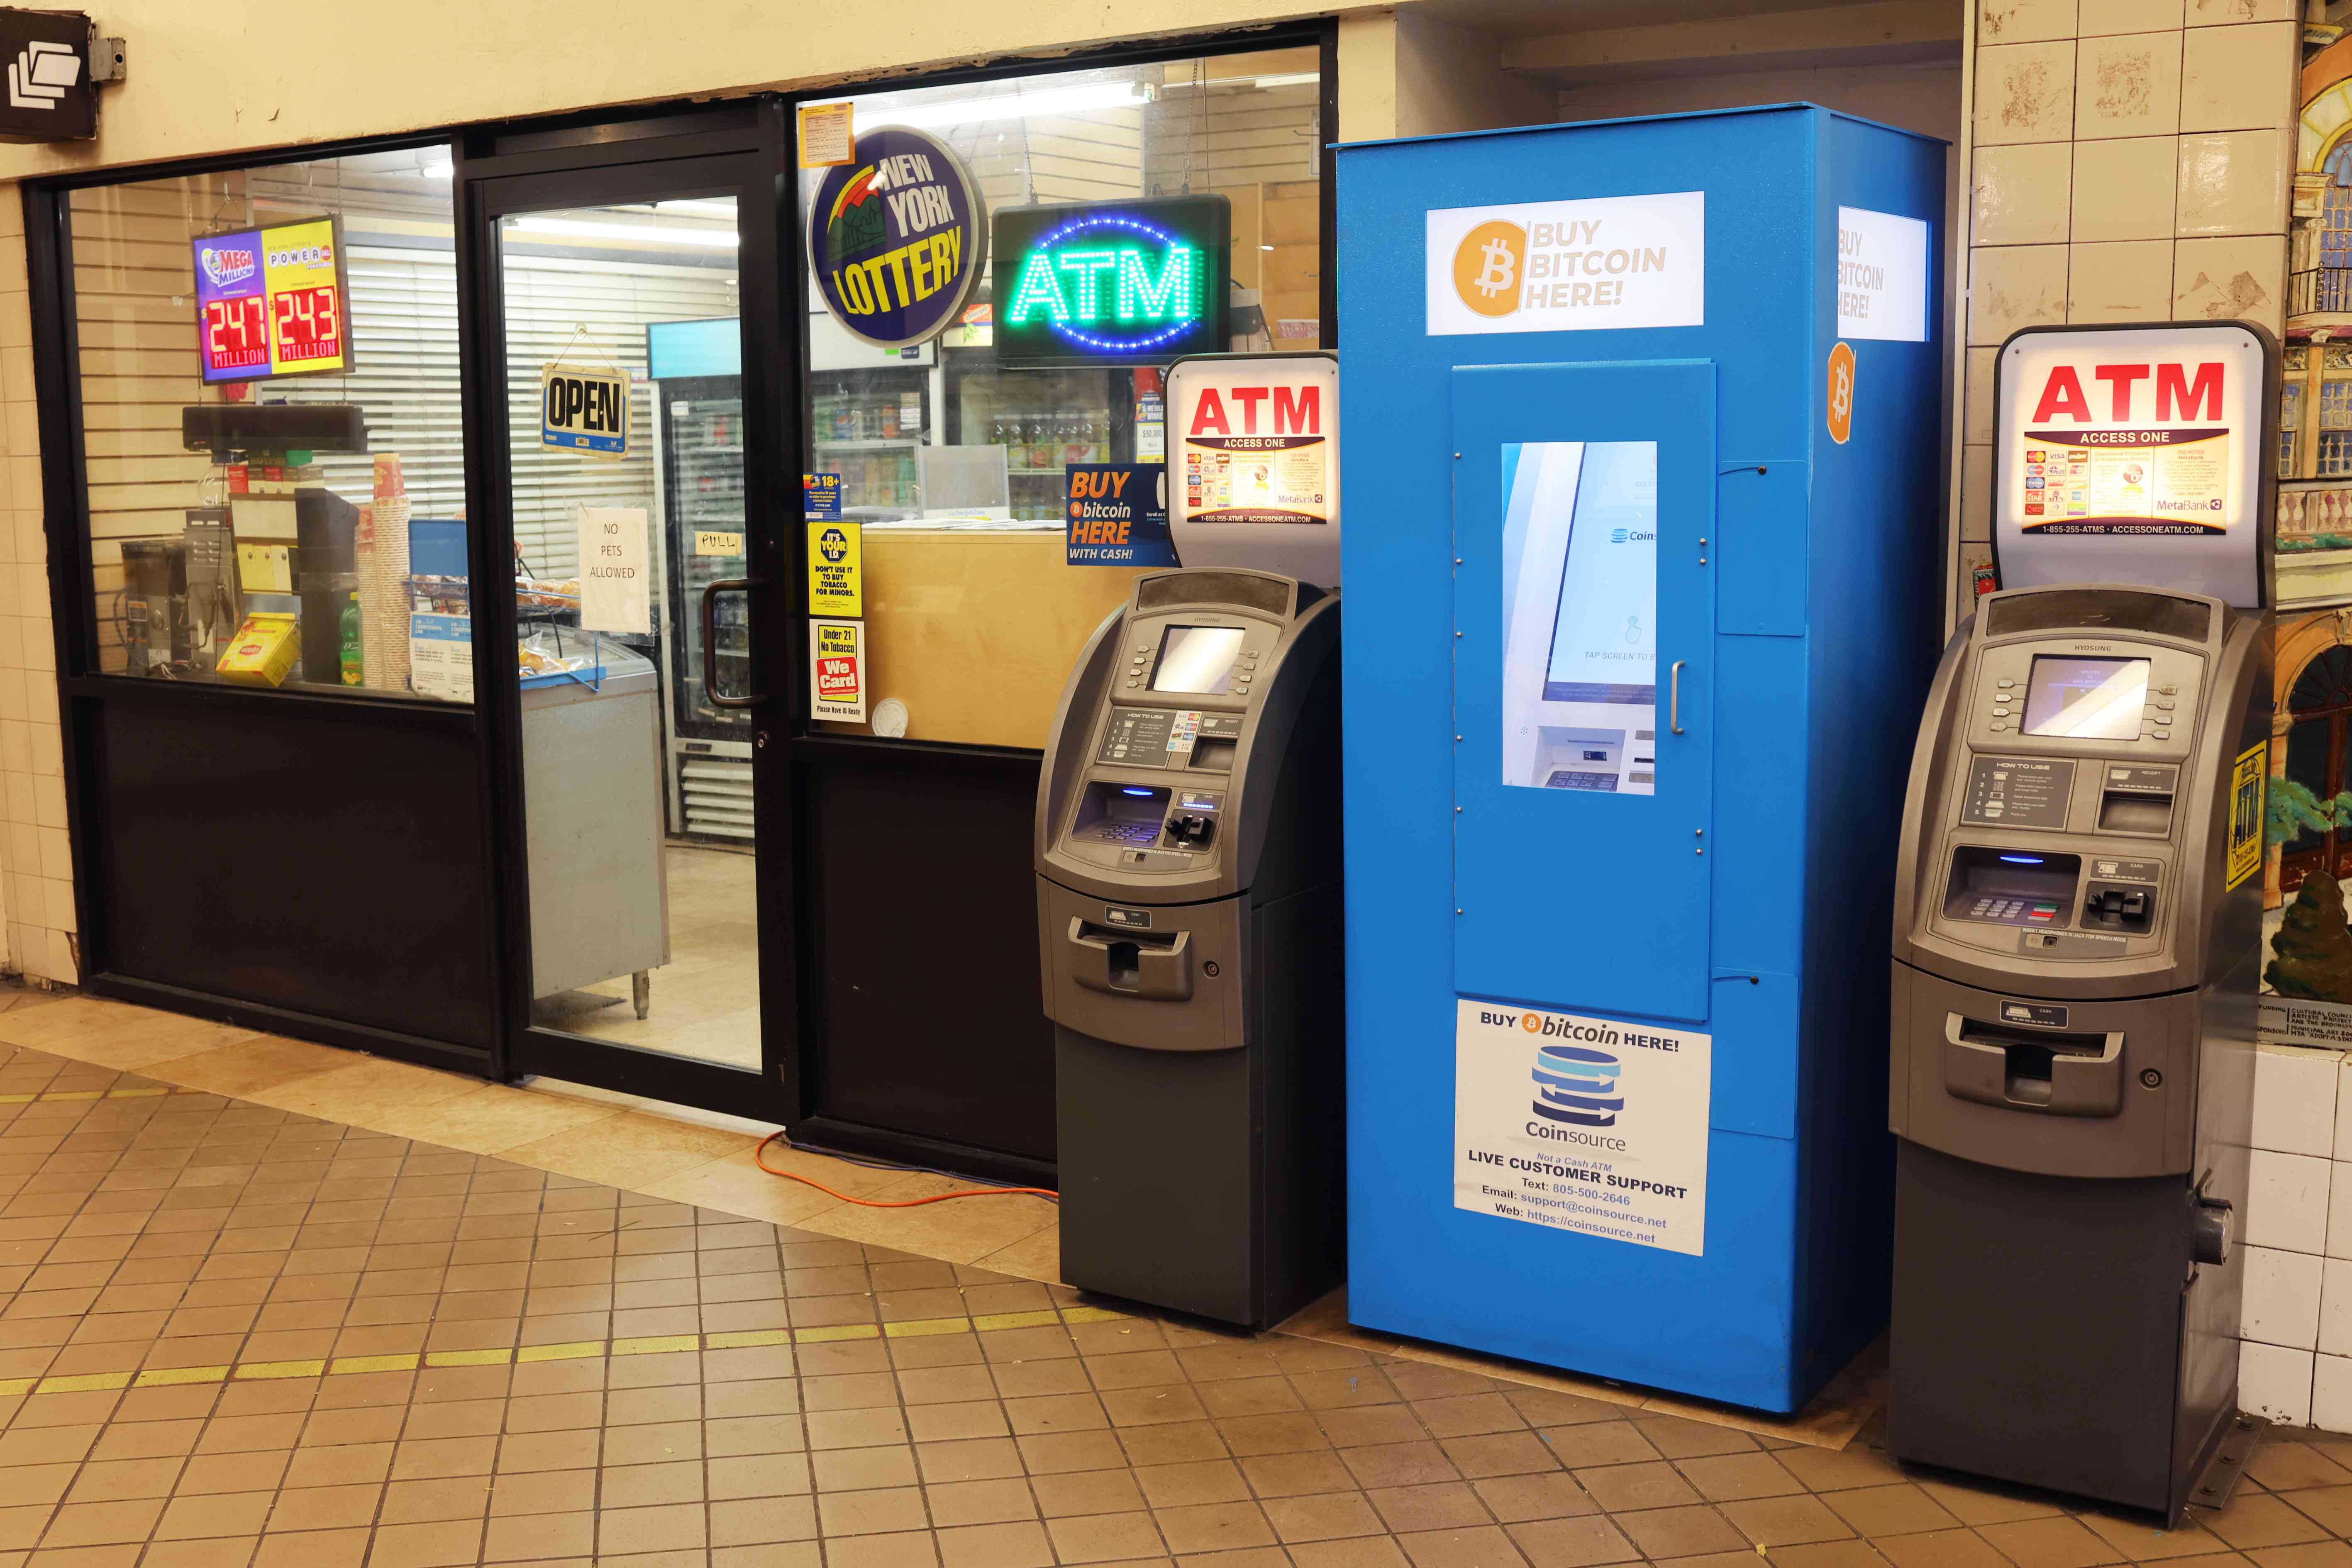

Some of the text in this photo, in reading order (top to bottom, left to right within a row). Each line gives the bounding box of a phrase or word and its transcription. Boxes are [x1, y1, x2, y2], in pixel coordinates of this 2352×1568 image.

[879, 153, 934, 191] NEW
[887, 185, 954, 238] YORK
[1532, 219, 1603, 248] BUY
[220, 249, 254, 273] MEGA
[271, 249, 320, 266] POWER
[1529, 246, 1667, 279] BITCOIN
[218, 267, 254, 285] MILLIONS
[832, 225, 961, 315] LOTTERY
[1010, 248, 1190, 322] ATM
[1525, 280, 1624, 309] HERE!
[214, 349, 266, 367] MILLION
[282, 341, 336, 361] MILLION
[2032, 362, 2225, 422] ATM
[549, 377, 620, 433] OPEN
[1190, 386, 1319, 435] ATM
[1142, 429, 1162, 438] $50,000
[2080, 432, 2170, 444] ACCESS ONE
[1224, 439, 1285, 448] ACCESS ONE
[822, 476, 839, 488] 18+
[1070, 471, 1132, 498] BUY
[1278, 495, 1314, 504] MetaBank
[2157, 500, 2209, 511] MetaBank
[1082, 501, 1131, 518] bitcoin
[604, 524, 618, 534] NO
[827, 533, 840, 541] IT'S
[1070, 521, 1132, 545] HERE
[702, 534, 735, 547] PULL
[821, 541, 847, 551] YOUR
[601, 546, 622, 556] PETS
[1069, 549, 1133, 560] WITH CASH!
[590, 567, 635, 578] ALLOWED
[824, 629, 851, 640] Under 21
[821, 641, 854, 653] No Tobacco
[824, 660, 850, 675] We
[820, 673, 856, 689] Card
[848, 707, 860, 717] Ready
[2232, 777, 2260, 851] ATM
[2039, 929, 2068, 937] HEADPHONES
[2291, 1008, 2325, 1017] CULTURAL
[1481, 1011, 1680, 1053] BUY bitcoin HERE!
[2291, 1025, 2324, 1034] MUNICIPAL
[1525, 1121, 1627, 1152] Coinsource
[1536, 1152, 1553, 1163] Not
[1564, 1156, 1590, 1169] Cash
[1590, 1161, 1613, 1173] ATM
[1468, 1149, 1688, 1200] LIVE CUSTOMER SUPPORT
[1521, 1177, 1631, 1206] Text: 805-500-2646
[1481, 1184, 1667, 1229] Email: support@coinsource.net
[1495, 1202, 1656, 1244] Web: https://coinsource.net
